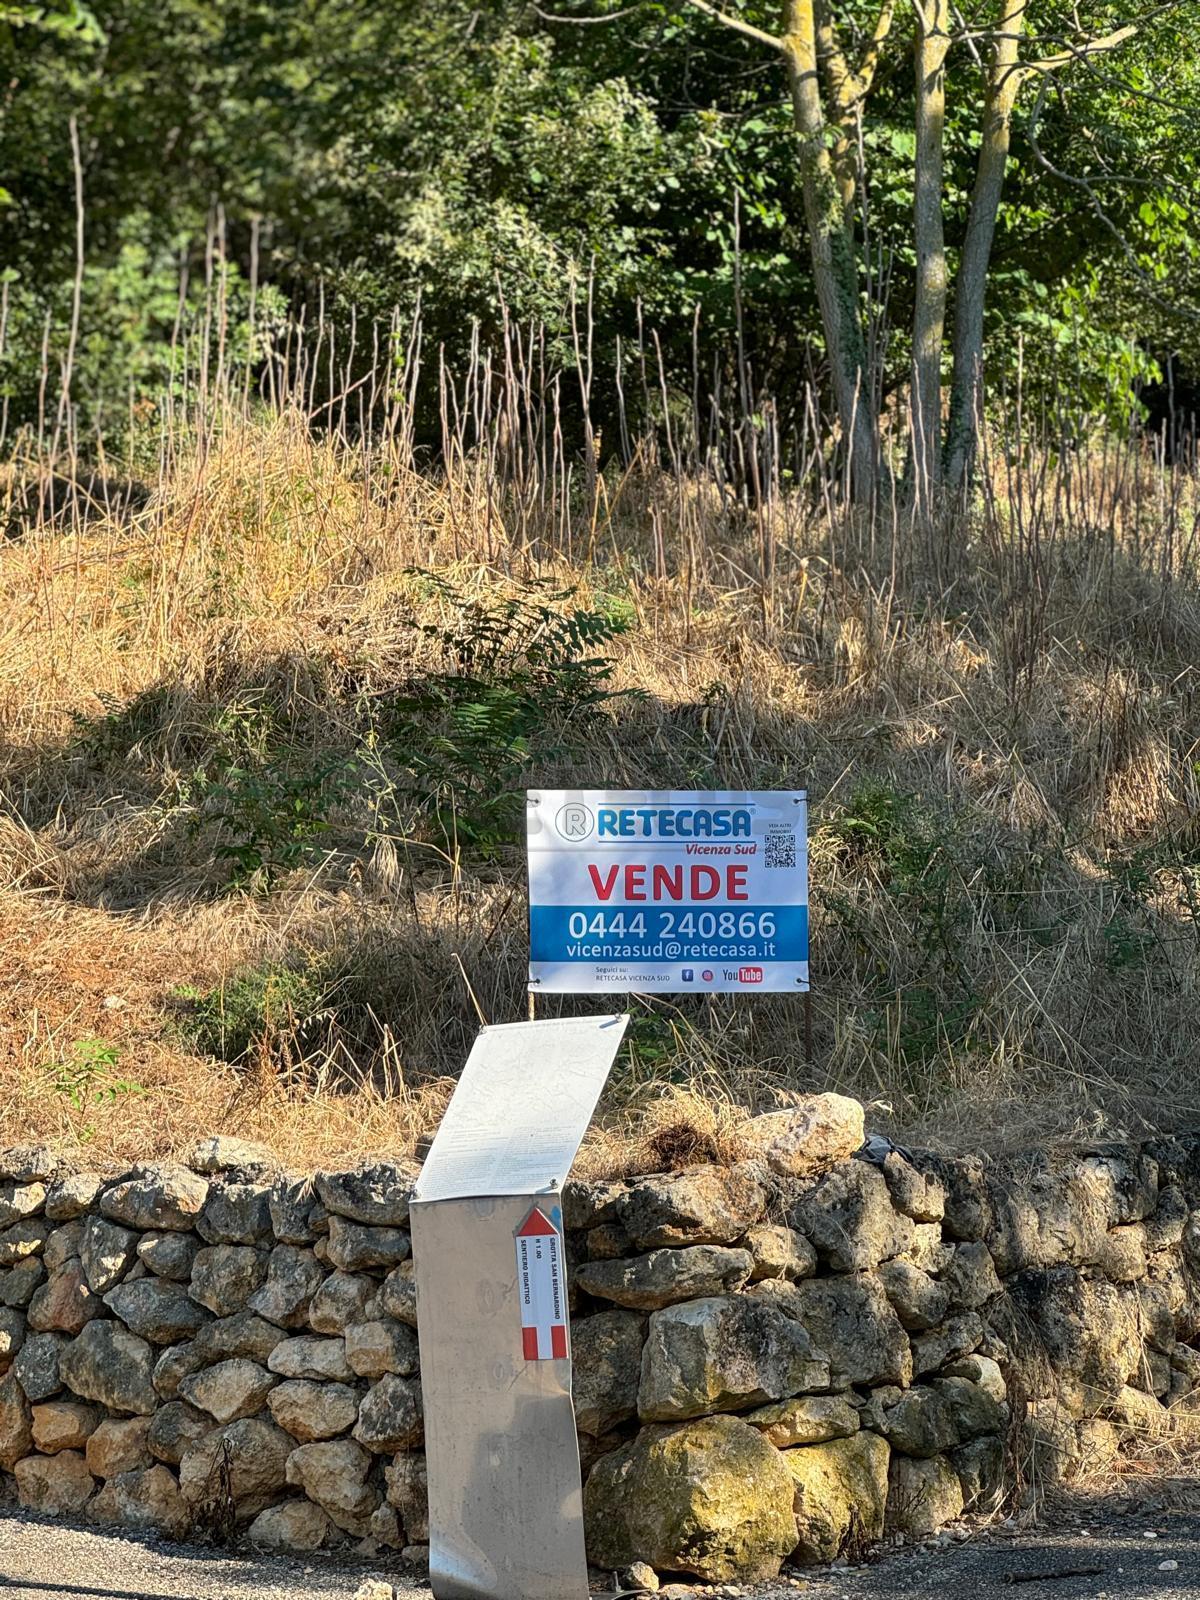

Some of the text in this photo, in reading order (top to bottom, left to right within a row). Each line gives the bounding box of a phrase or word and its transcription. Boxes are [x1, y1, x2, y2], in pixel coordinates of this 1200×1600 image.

[598, 809, 751, 837] RETECASA
[686, 844, 757, 856] Vicenza Sud
[588, 864, 748, 900] VENDE
[568, 912, 776, 938] 0444 240866
[566, 942, 776, 959] vicenzasud@retecasa.it
[722, 968, 762, 981] YouTube
[552, 1278, 560, 1320] BERNARDINO
